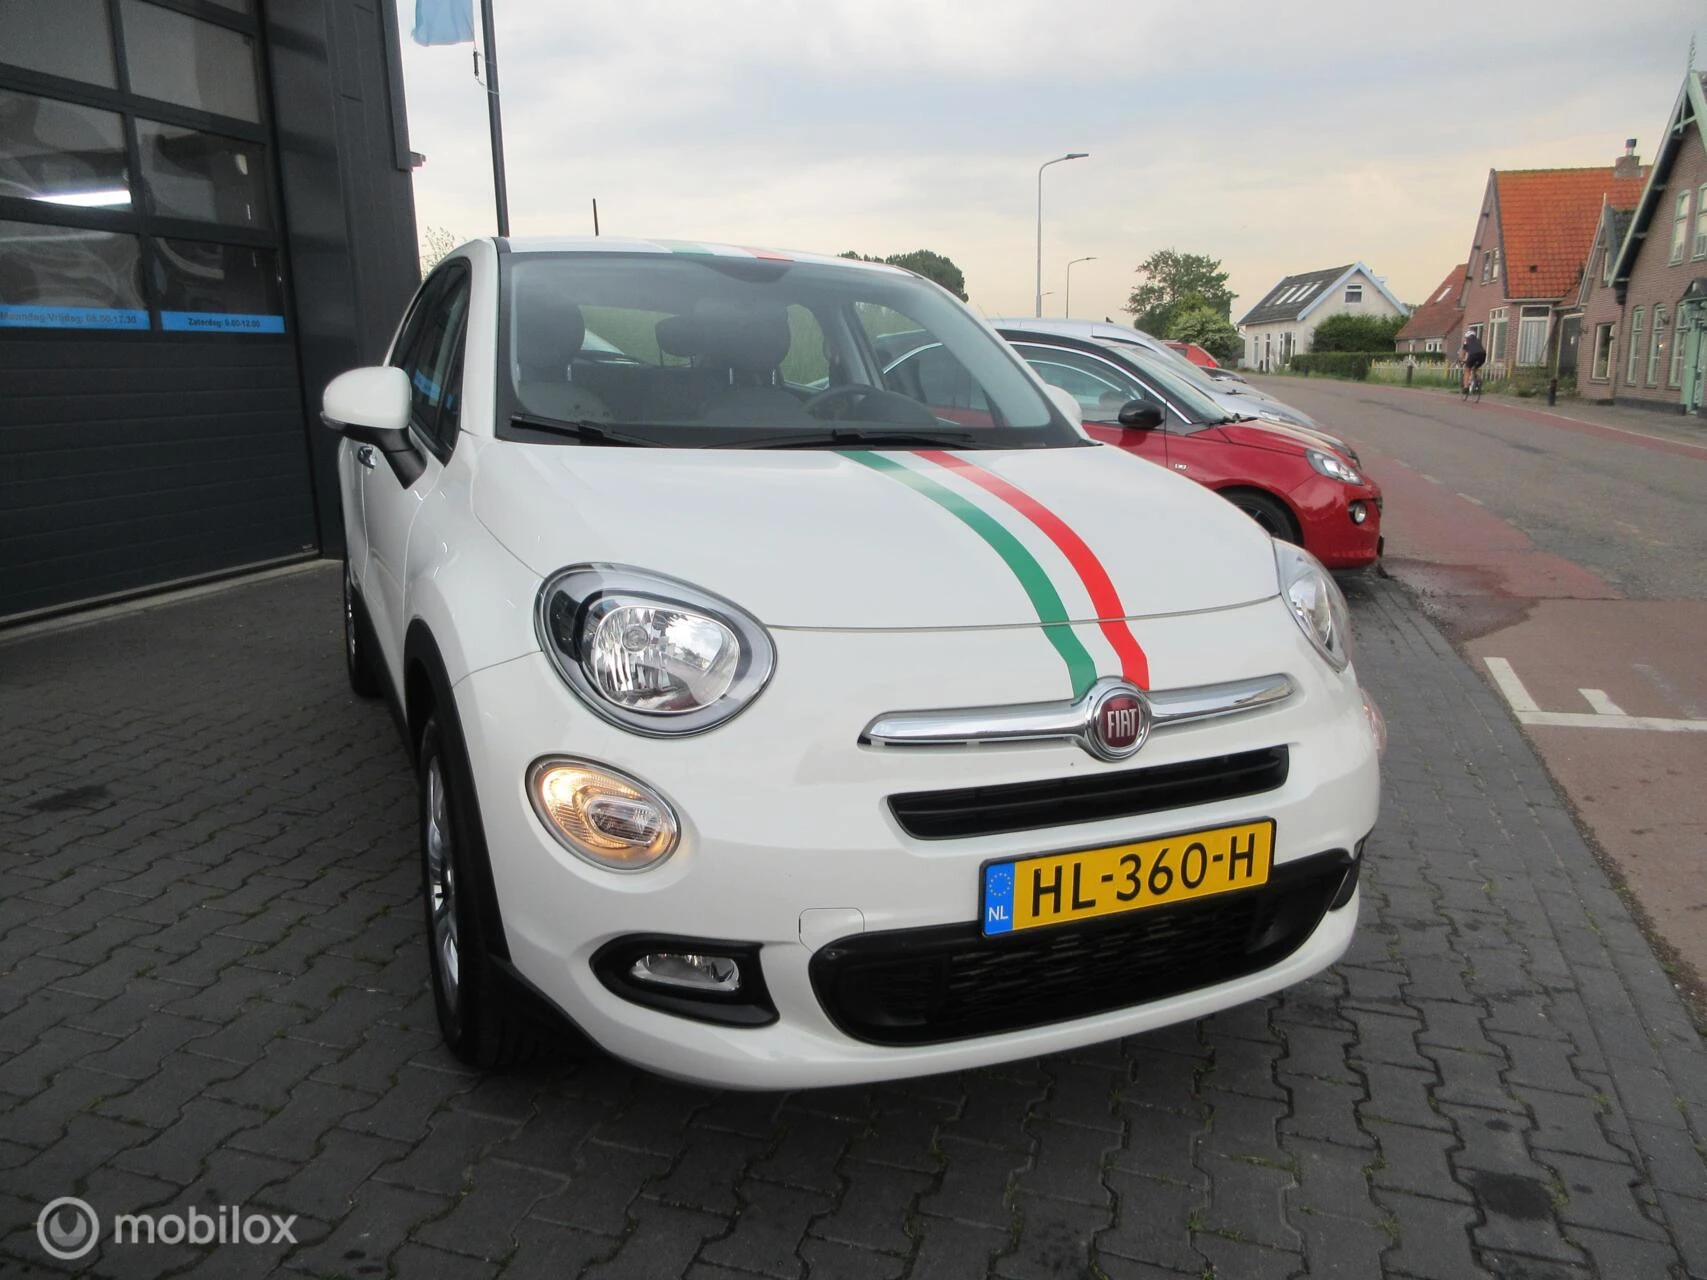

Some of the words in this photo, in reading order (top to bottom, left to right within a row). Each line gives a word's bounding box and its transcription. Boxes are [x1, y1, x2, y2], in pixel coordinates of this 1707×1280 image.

[1107, 708, 1137, 739] FIAT
[1031, 832, 1256, 917] HL-360-H
[988, 905, 1009, 922] NL
